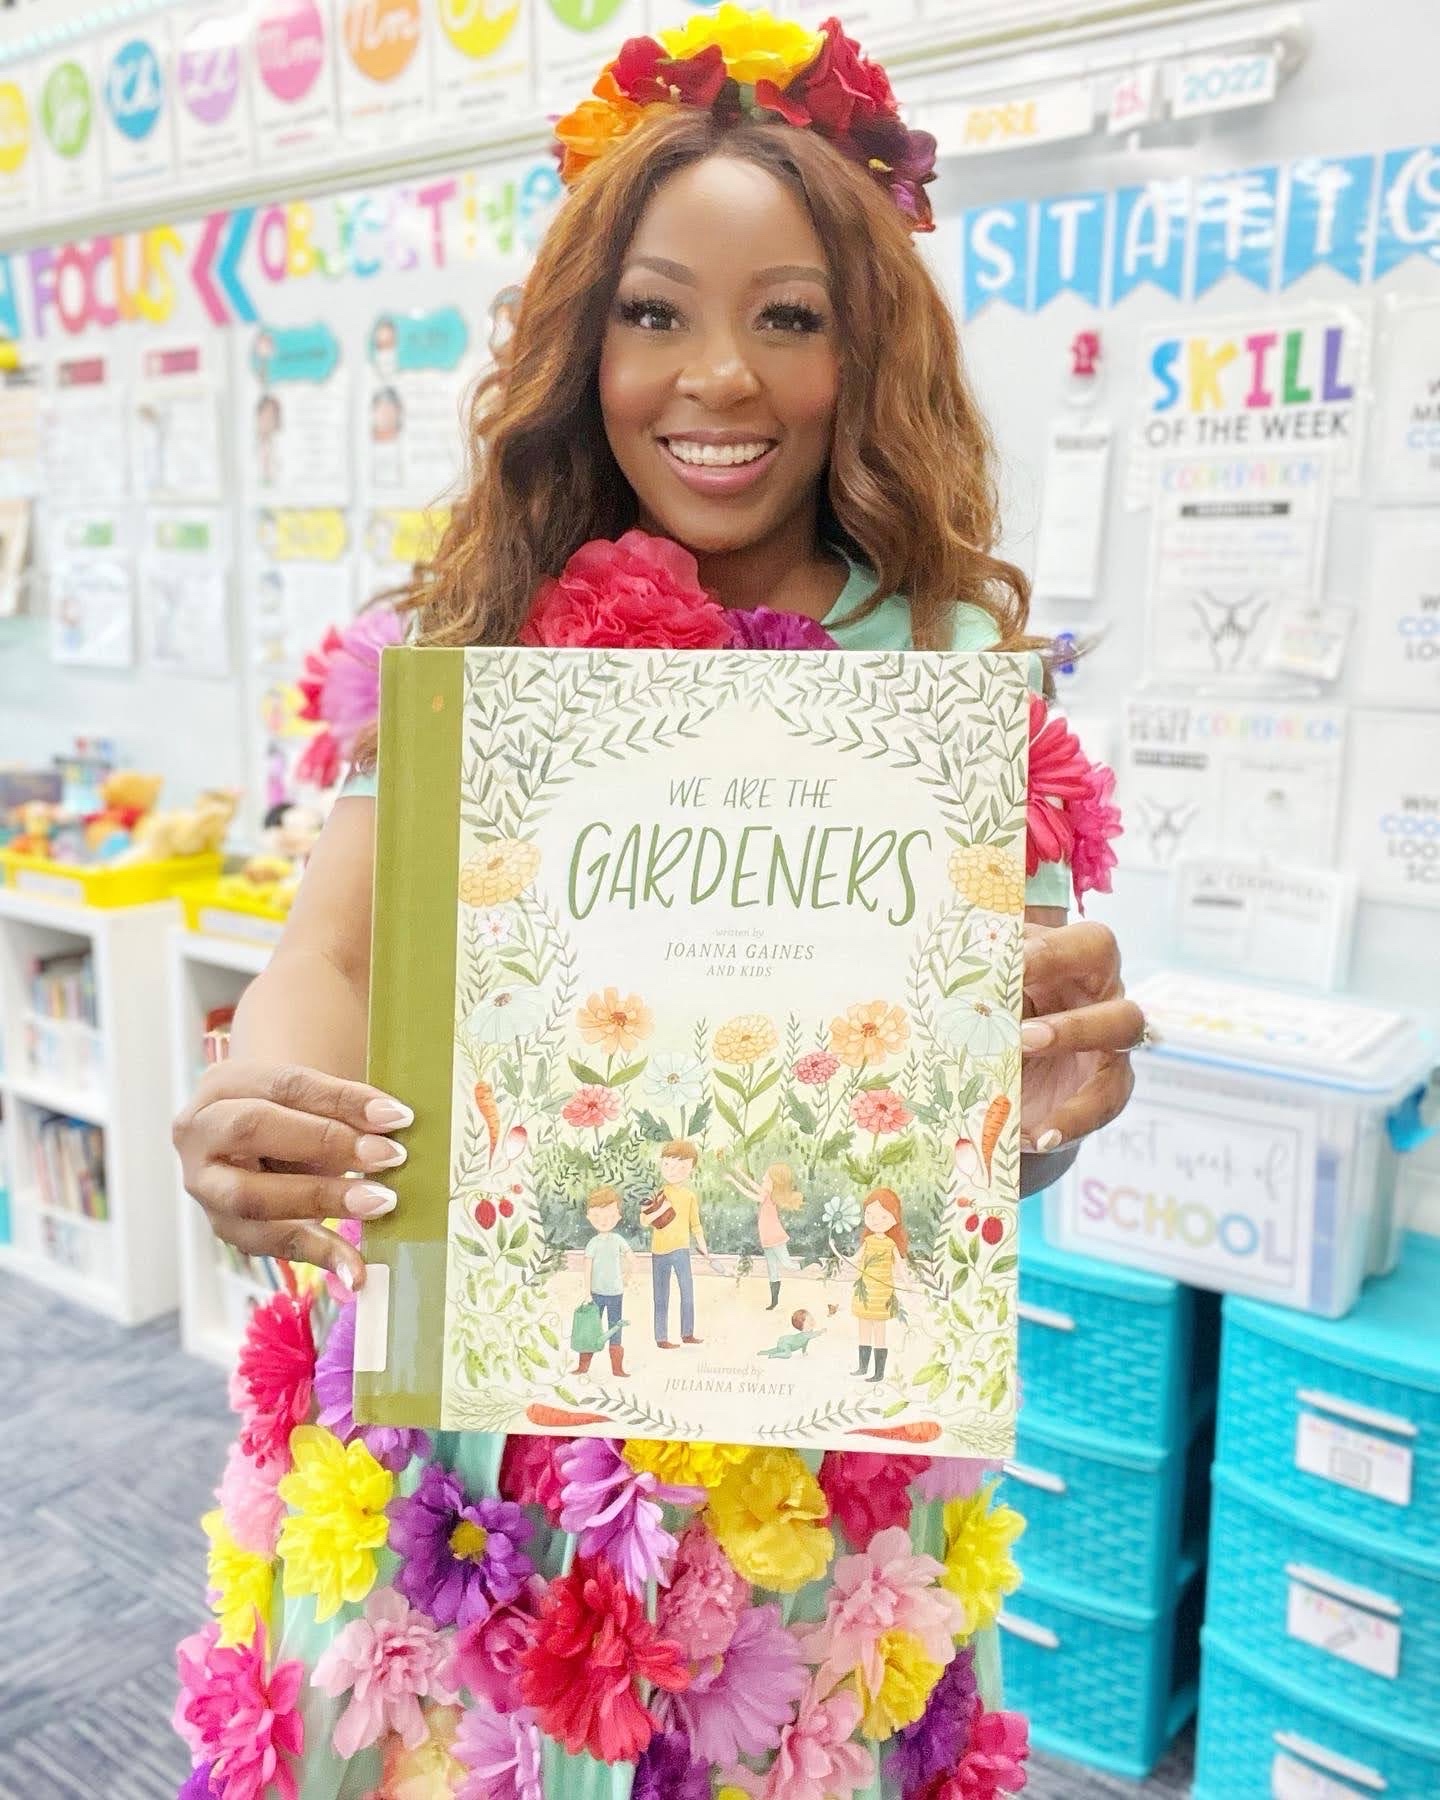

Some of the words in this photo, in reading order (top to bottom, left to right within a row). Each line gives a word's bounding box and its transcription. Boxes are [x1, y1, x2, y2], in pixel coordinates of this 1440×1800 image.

[1183, 58, 1267, 104] 2022
[28, 222, 185, 338] FOCUS
[1151, 327, 1354, 412] SKILL
[1144, 420, 1185, 449] OF
[1198, 418, 1249, 444] THE
[1260, 410, 1351, 441] WEEK
[669, 776, 713, 809] WE
[723, 776, 777, 810] ARE
[786, 777, 838, 809] THE
[567, 820, 933, 927] GARDENERS
[713, 927, 750, 938] written
[752, 927, 765, 939] by
[665, 942, 737, 961] JOANNA
[745, 943, 815, 961] GAINES
[706, 964, 735, 977] AND
[740, 965, 773, 977] KIDS
[1081, 1176, 1295, 1266] SCHOOL
[664, 1378, 733, 1394] JULIANNA
[738, 1382, 794, 1396] SWANEY
[751, 1364, 764, 1377] by
